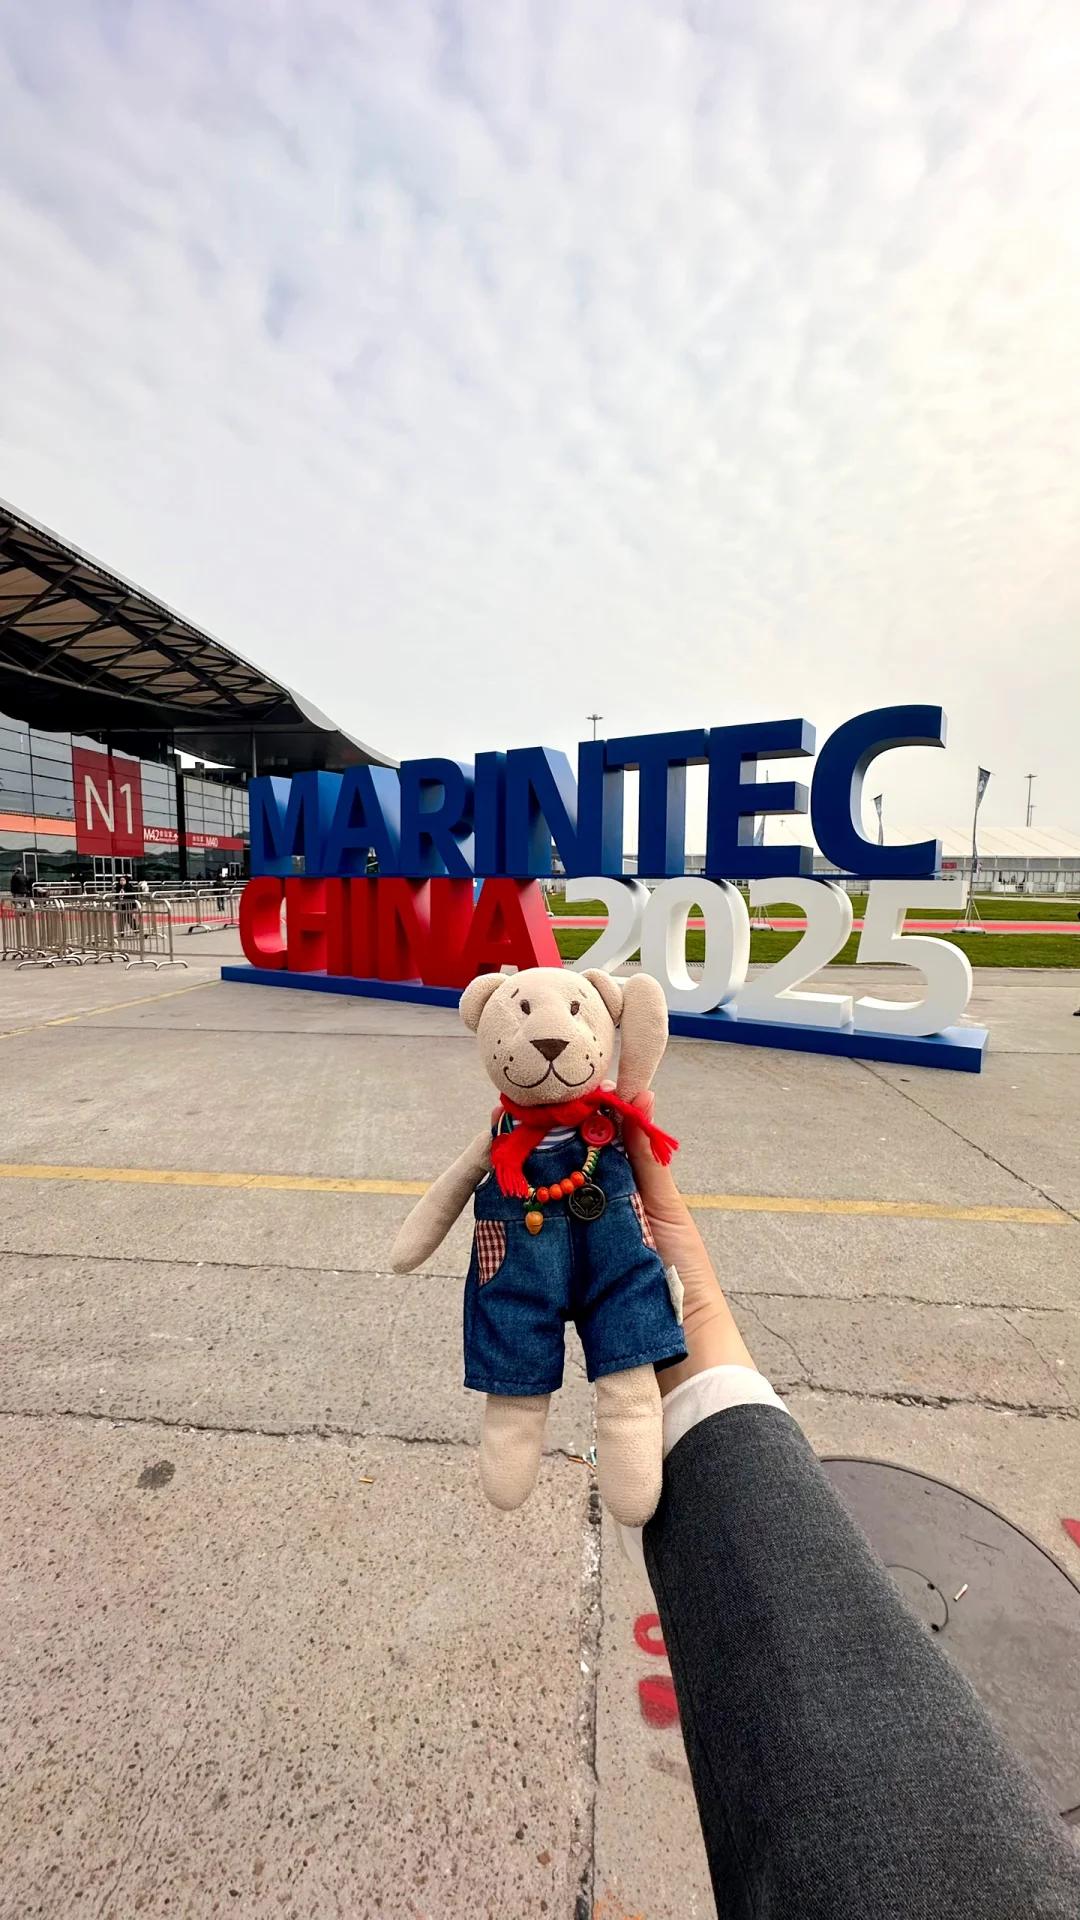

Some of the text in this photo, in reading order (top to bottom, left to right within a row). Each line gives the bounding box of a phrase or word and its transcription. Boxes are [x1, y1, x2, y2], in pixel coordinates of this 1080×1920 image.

[84, 774, 133, 834] N1
[143, 828, 160, 841] M42
[248, 704, 947, 877] MARINTEC
[239, 875, 973, 1036] CHINA 2025
